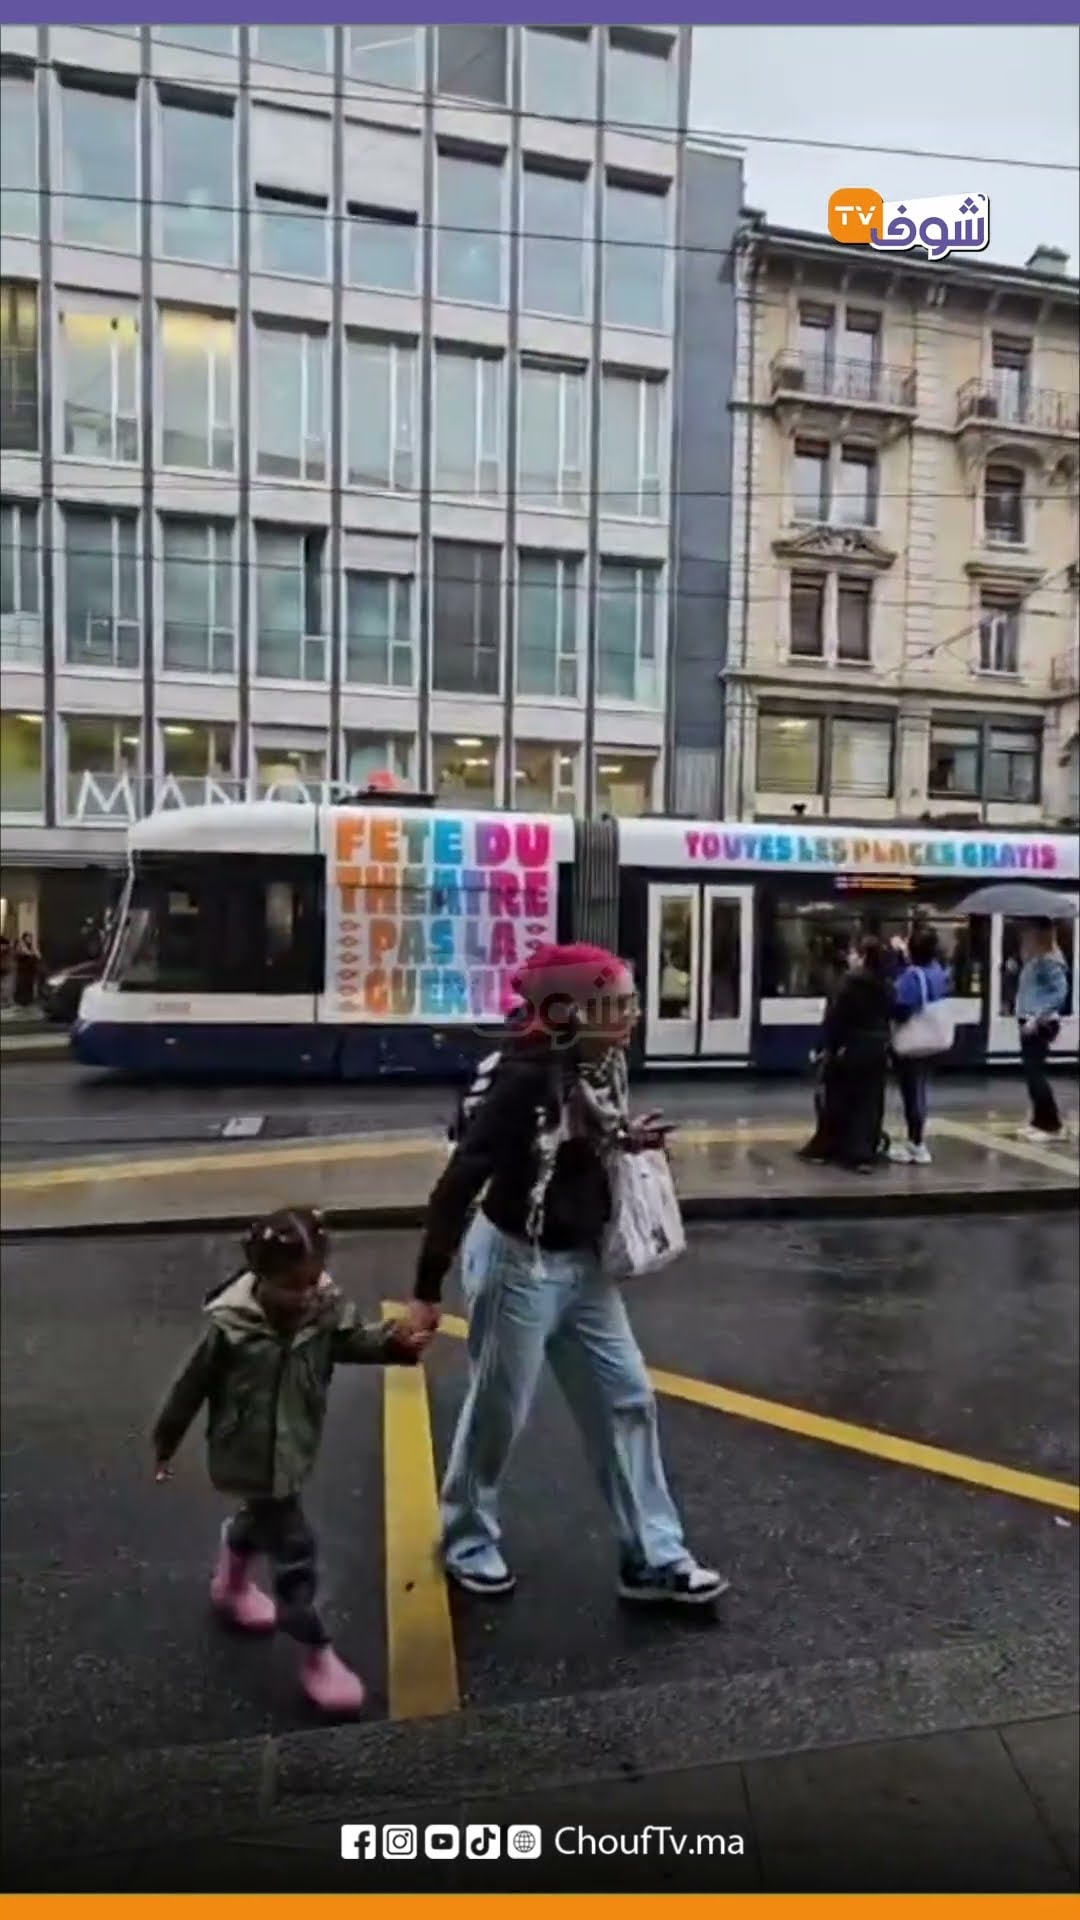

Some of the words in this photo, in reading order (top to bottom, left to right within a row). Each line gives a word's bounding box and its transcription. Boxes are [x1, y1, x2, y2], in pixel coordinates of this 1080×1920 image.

[475, 821, 550, 867] DU
[684, 830, 793, 861] TOUTES
[801, 834, 849, 864] LES
[852, 837, 956, 867] PLACES
[961, 840, 1057, 870] GRATIS
[336, 865, 549, 918] THEATRE
[368, 918, 455, 965] PAS
[465, 920, 519, 965] LA
